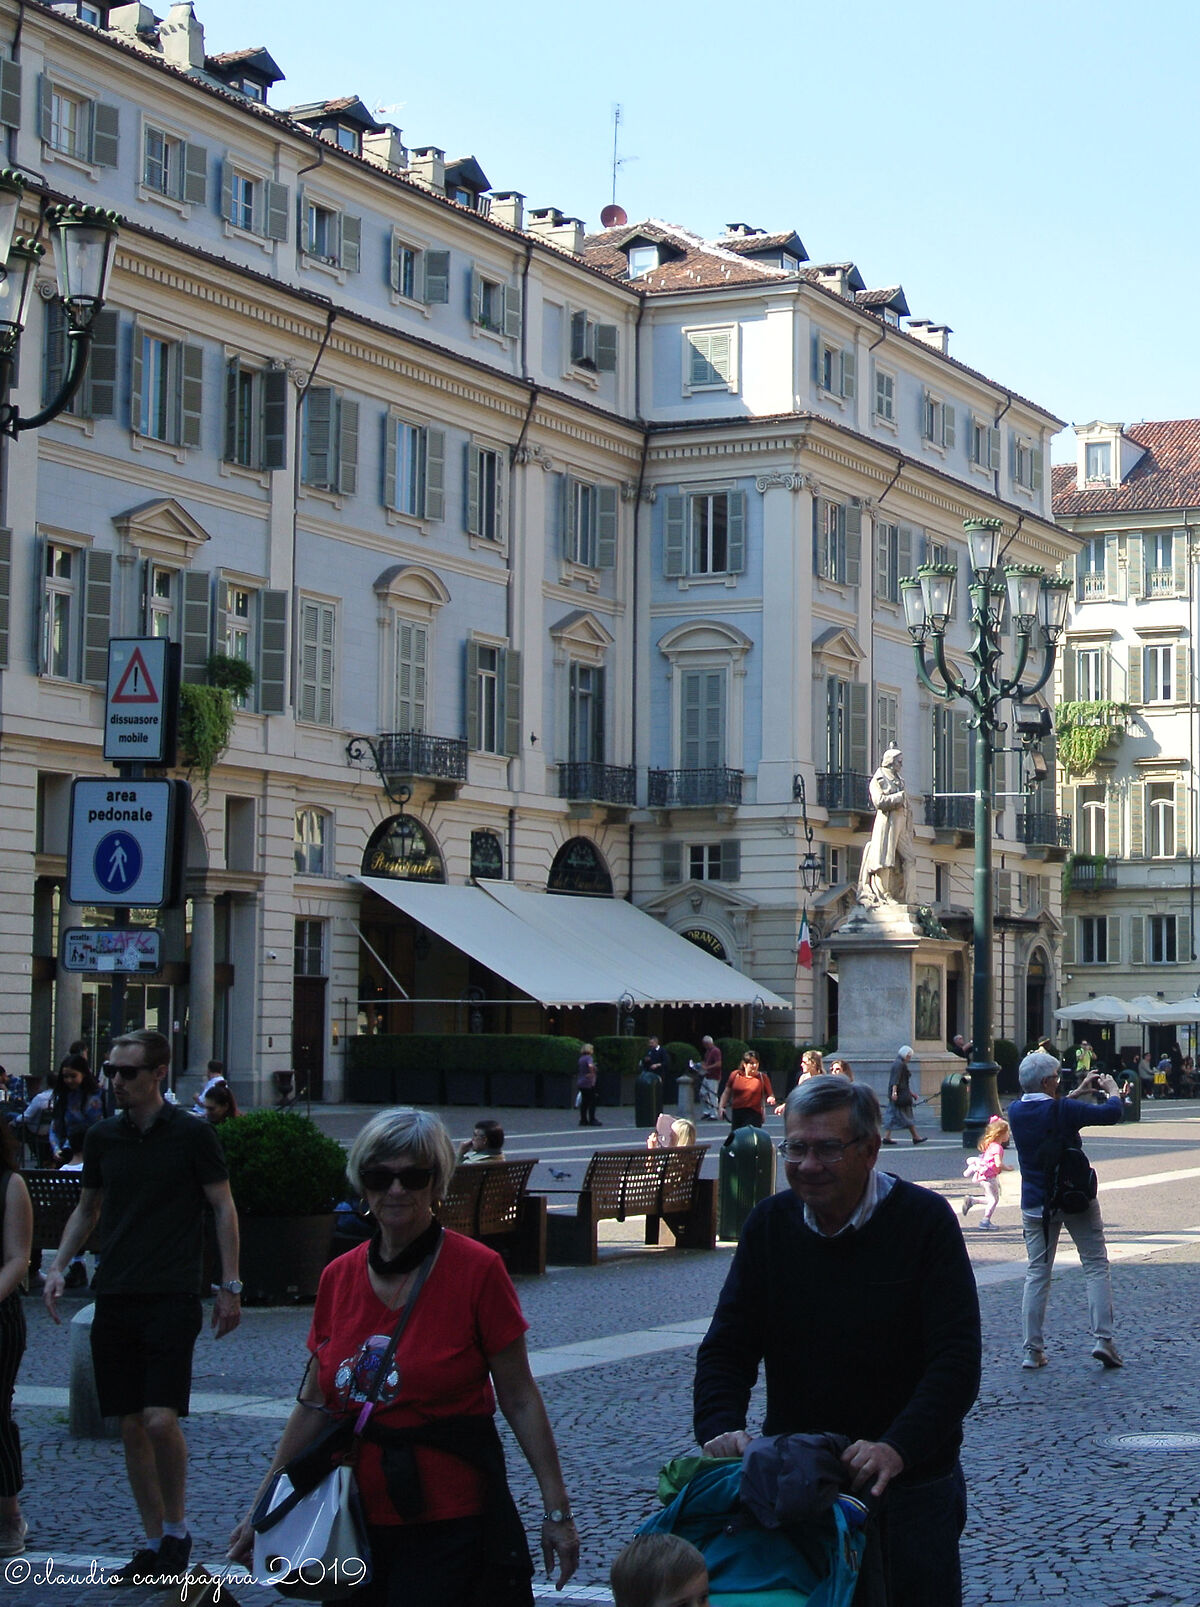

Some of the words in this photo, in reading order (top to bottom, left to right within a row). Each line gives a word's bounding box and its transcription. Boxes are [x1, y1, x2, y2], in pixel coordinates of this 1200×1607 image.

[110, 713, 159, 726] dissuasore
[118, 732, 149, 744] mobile
[106, 790, 138, 803] area
[88, 807, 153, 823] pedonale
[371, 851, 436, 873] Ristorante
[687, 930, 722, 953] ORANTE
